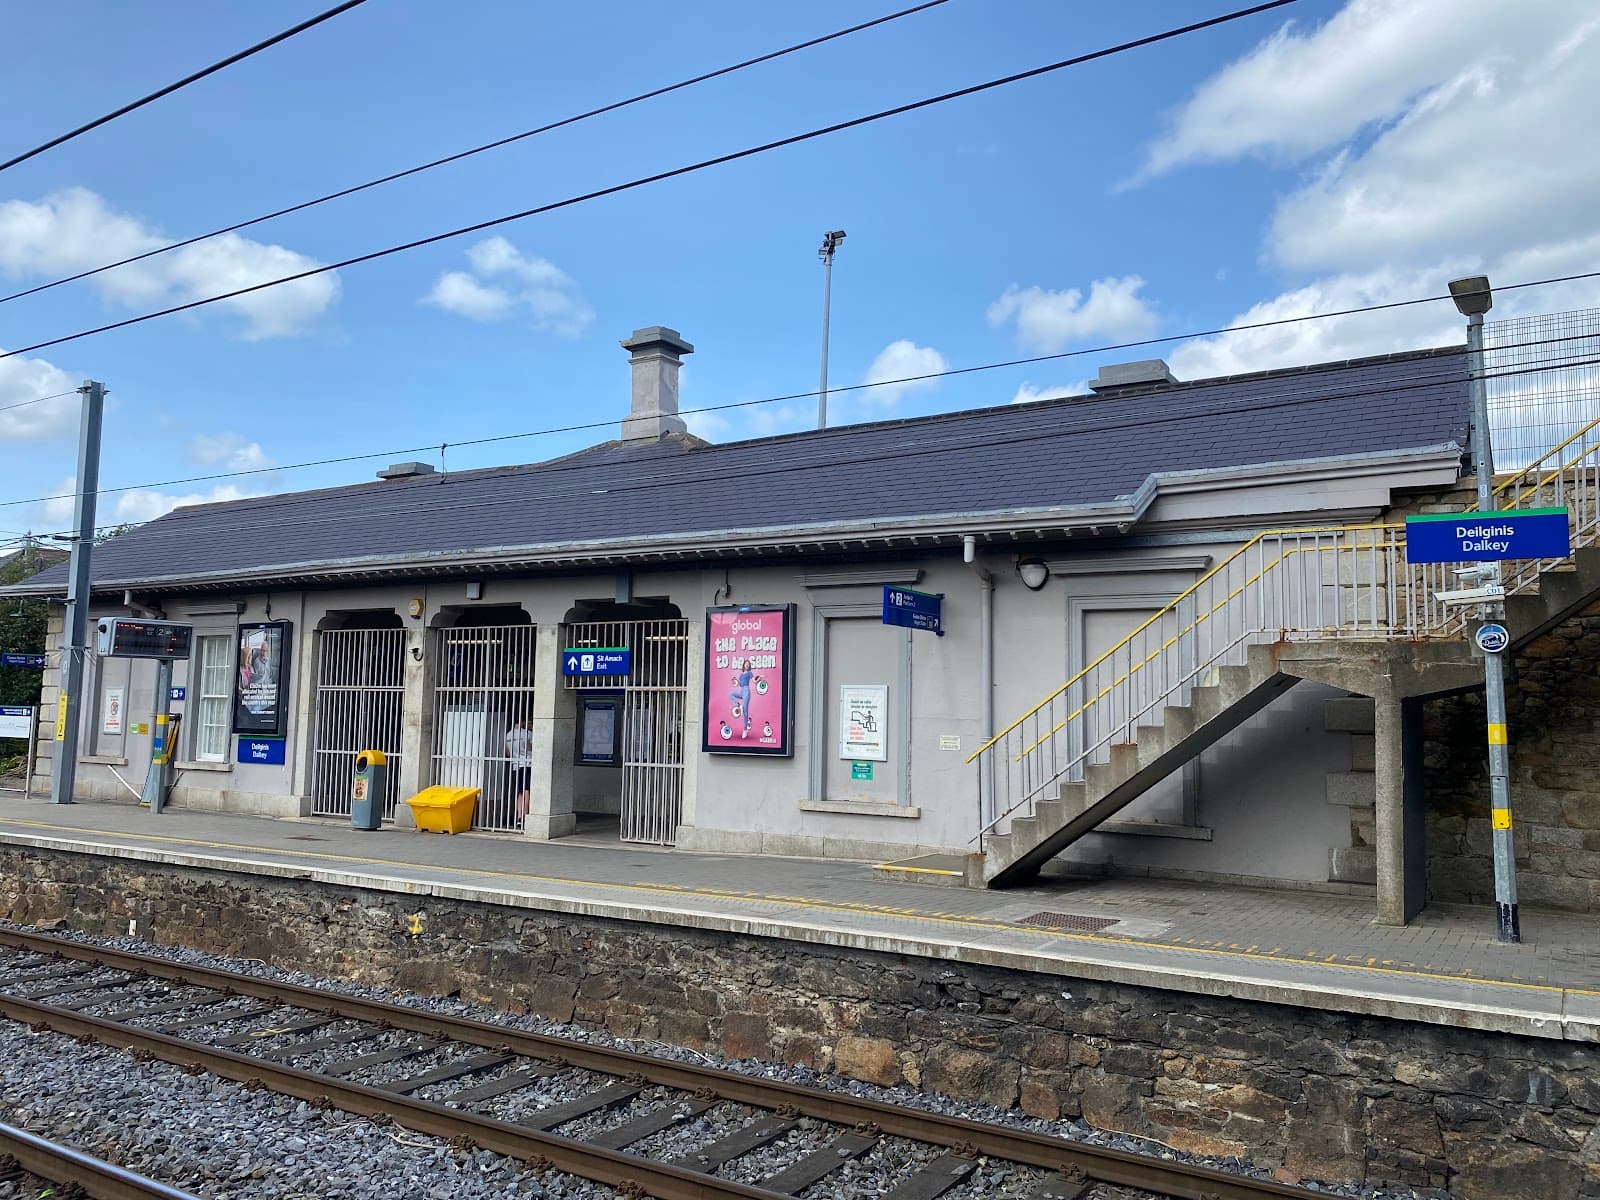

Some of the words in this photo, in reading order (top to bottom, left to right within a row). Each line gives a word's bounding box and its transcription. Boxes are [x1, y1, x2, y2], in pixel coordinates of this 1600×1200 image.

[1456, 525, 1514, 539] Deilginis
[1462, 540, 1509, 552] Dalkey
[732, 619, 762, 634] global
